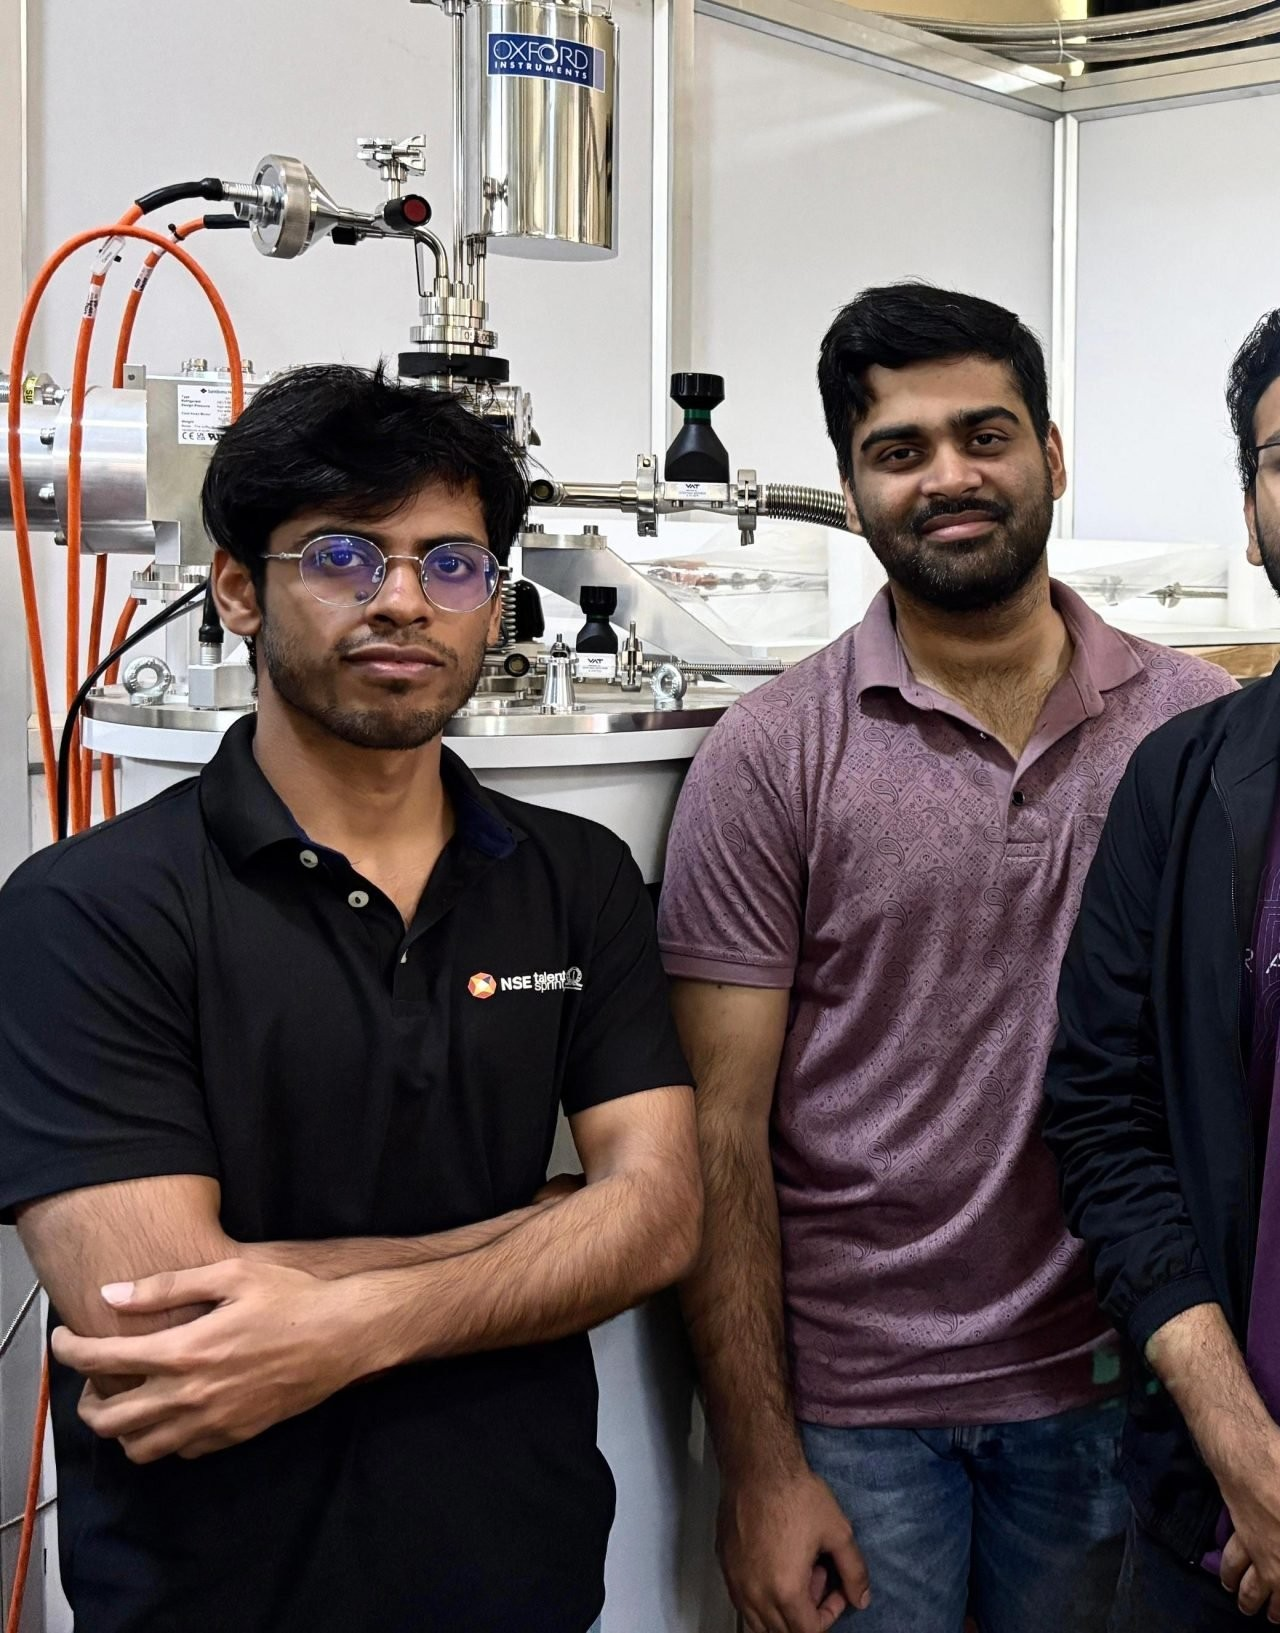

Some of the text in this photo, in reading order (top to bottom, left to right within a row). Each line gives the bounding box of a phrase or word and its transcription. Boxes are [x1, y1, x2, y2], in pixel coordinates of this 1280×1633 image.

[493, 39, 589, 70] OXFORD
[494, 61, 588, 80] INSTRUMENTS
[501, 970, 566, 991] NSE talent
